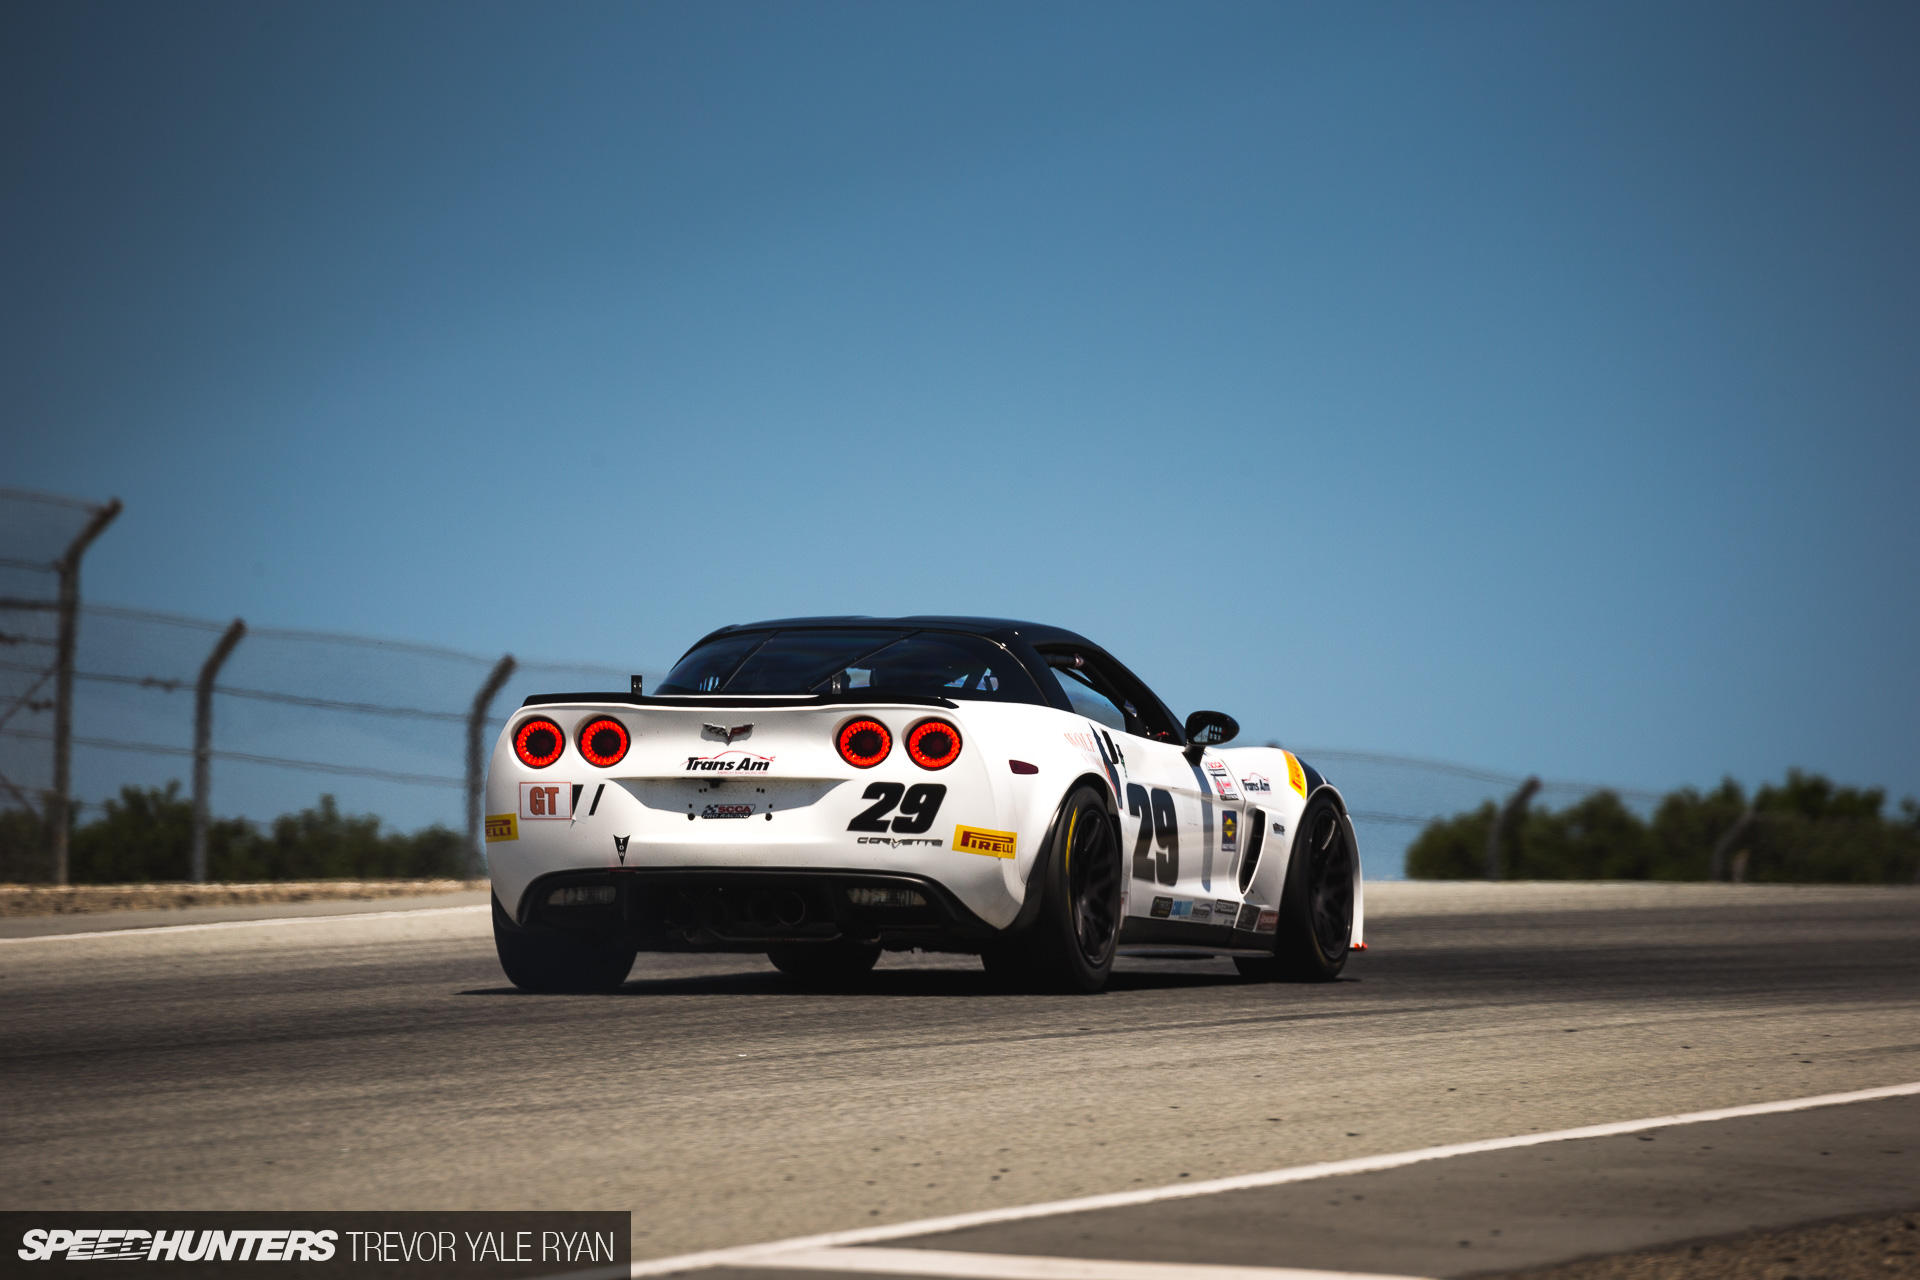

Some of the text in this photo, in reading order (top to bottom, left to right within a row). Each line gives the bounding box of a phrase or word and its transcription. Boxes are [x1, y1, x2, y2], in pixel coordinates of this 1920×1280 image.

[685, 757, 770, 771] Trans Am
[1241, 779, 1260, 792] Trans
[1259, 779, 1271, 792] Am
[529, 786, 560, 816] GT
[717, 805, 752, 814] SCCA
[846, 781, 948, 834] 29
[856, 836, 944, 849] CORVETTE
[960, 830, 1014, 854] PIRELLI
[1126, 782, 1180, 887] 29
